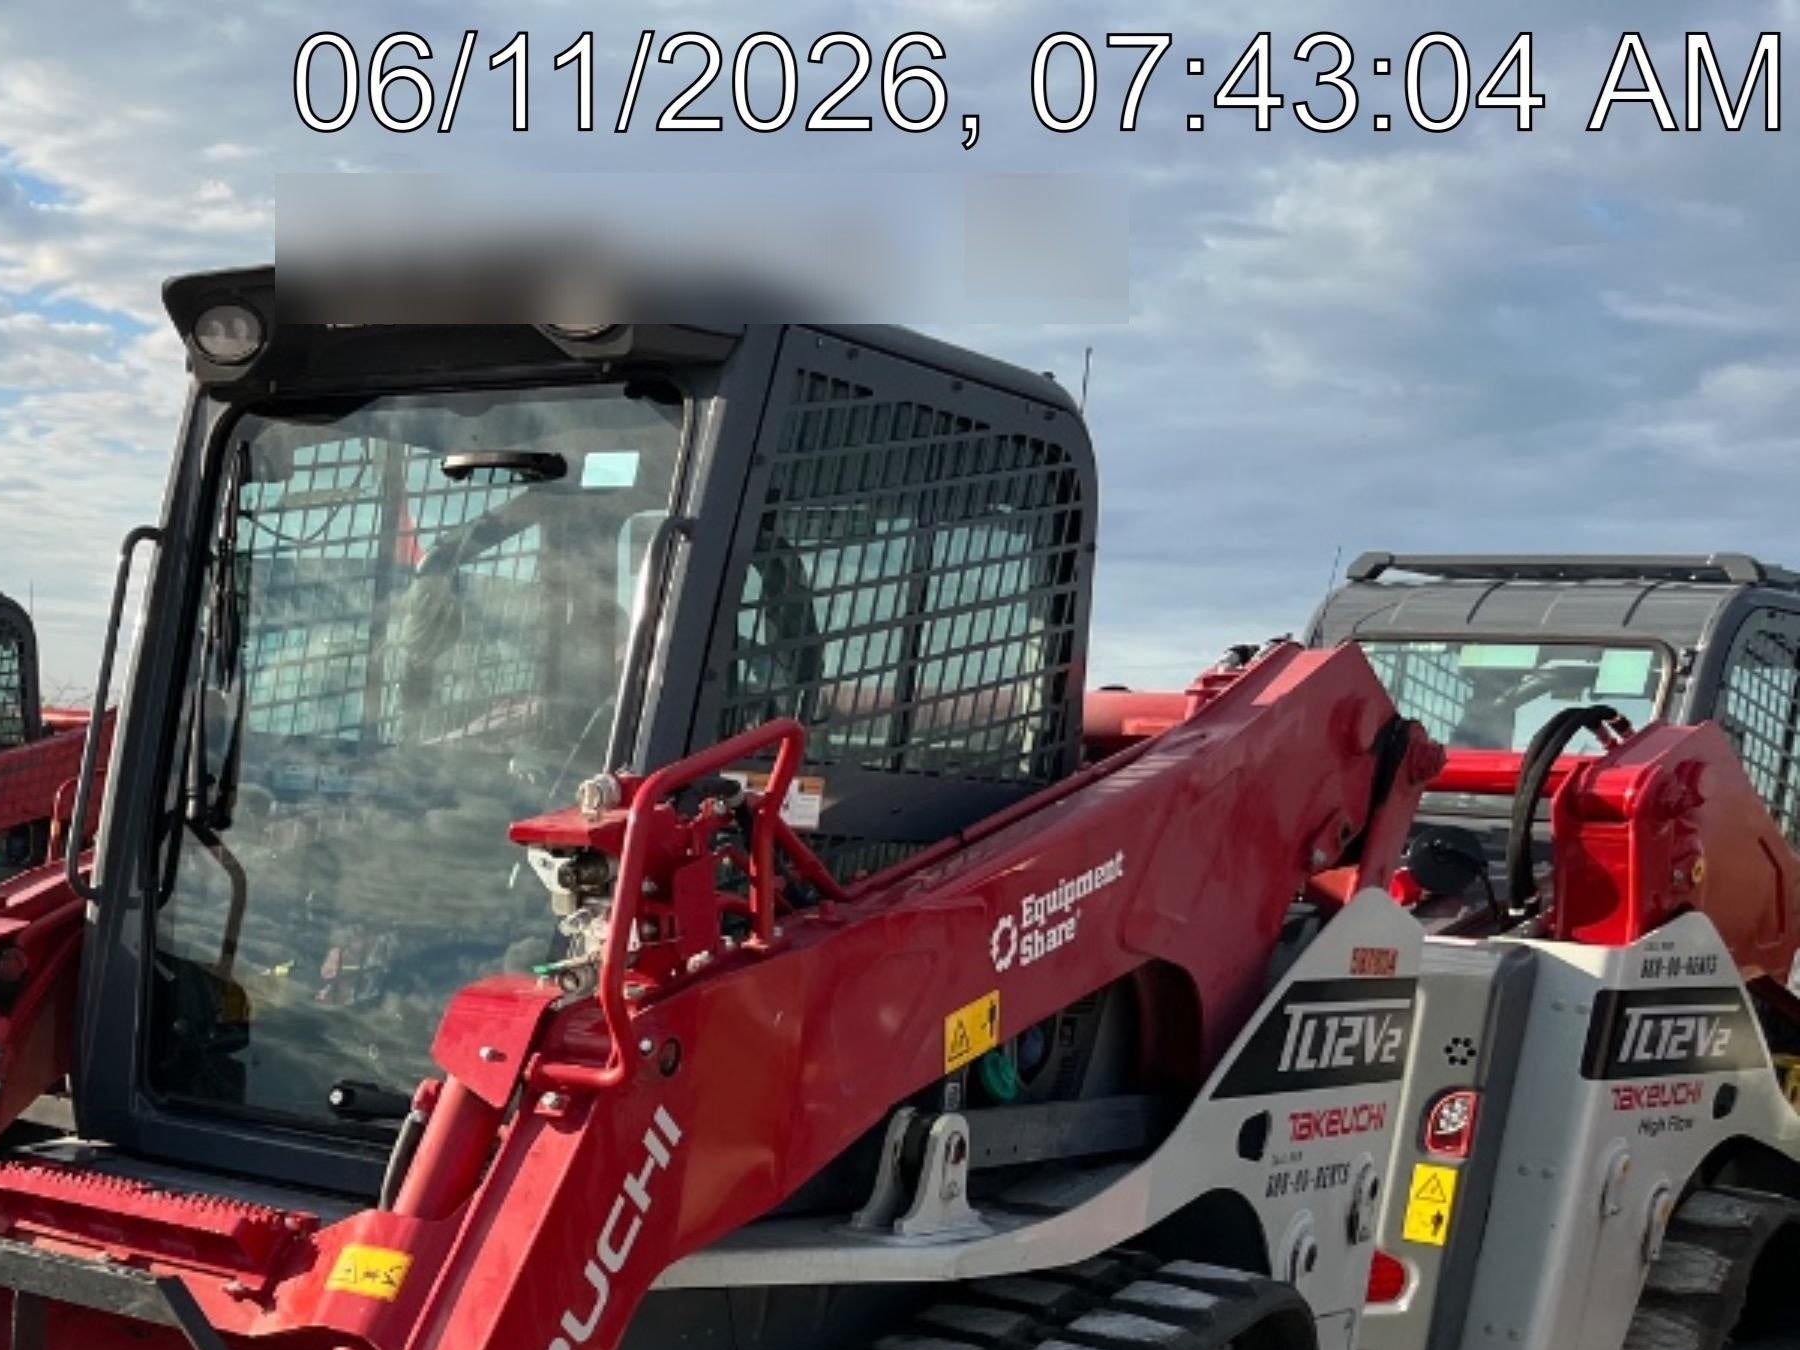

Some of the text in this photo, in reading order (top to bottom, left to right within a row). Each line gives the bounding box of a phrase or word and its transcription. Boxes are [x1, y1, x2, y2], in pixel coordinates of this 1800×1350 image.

[1021, 851, 1126, 929] Equipment
[1020, 916, 1076, 967] Share
[1611, 1080, 1704, 1111] TAKEUCHI
[1288, 1103, 1387, 1141] TAKEUCHI
[1638, 1116, 1666, 1137] High
